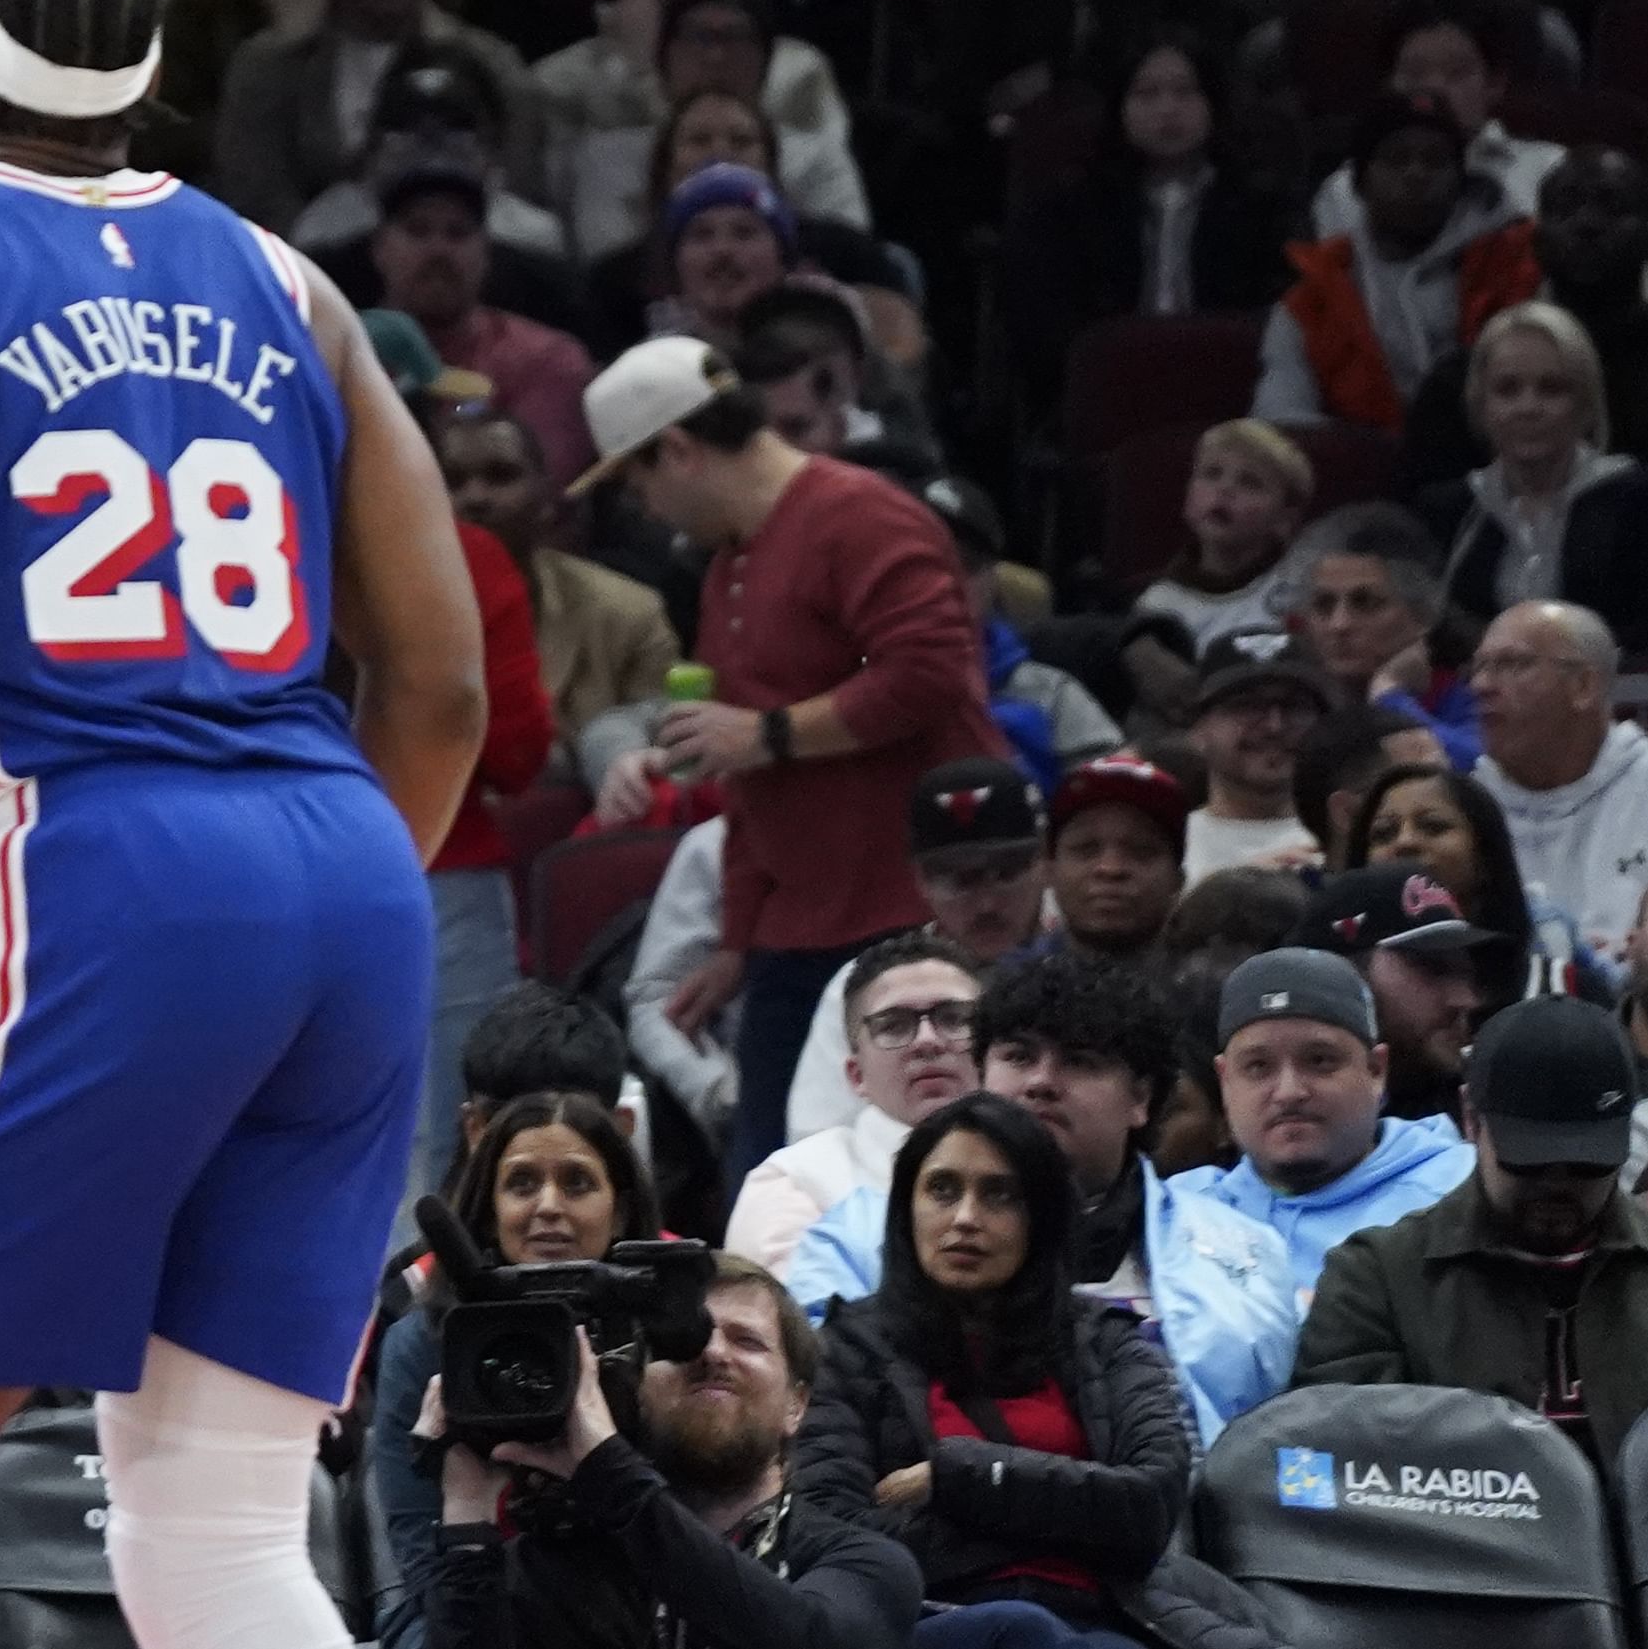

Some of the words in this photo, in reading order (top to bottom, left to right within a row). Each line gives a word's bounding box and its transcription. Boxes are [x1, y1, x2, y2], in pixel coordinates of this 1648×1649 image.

[9, 428, 306, 666] 28
[1345, 1460, 1392, 1492] LA
[1400, 1465, 1541, 1500] RABIDA
